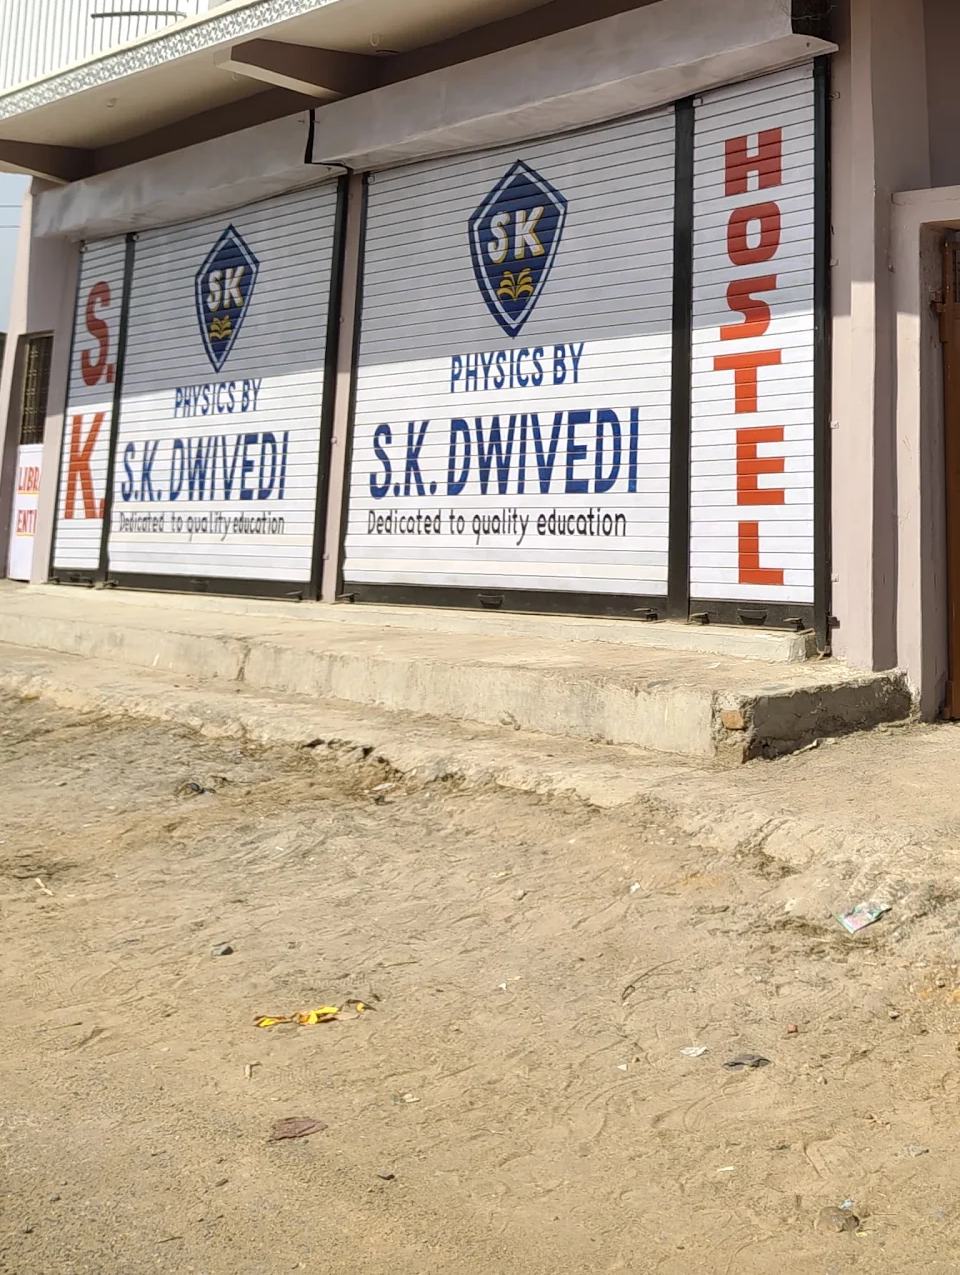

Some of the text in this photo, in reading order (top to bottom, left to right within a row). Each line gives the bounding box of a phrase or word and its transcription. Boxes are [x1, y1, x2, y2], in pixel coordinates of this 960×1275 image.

[487, 205, 545, 264] SK
[207, 266, 245, 312] SK
[450, 342, 585, 393] PHYSICS BY
[713, 127, 785, 586] HOSTEL
[174, 378, 262, 418] PHYSICS BY
[169, 431, 289, 501] DWIVEDI
[447, 407, 639, 495] DWIVEDI
[119, 510, 285, 542] Dedicated to quality education
[367, 508, 627, 545] Dedicated to quality education
